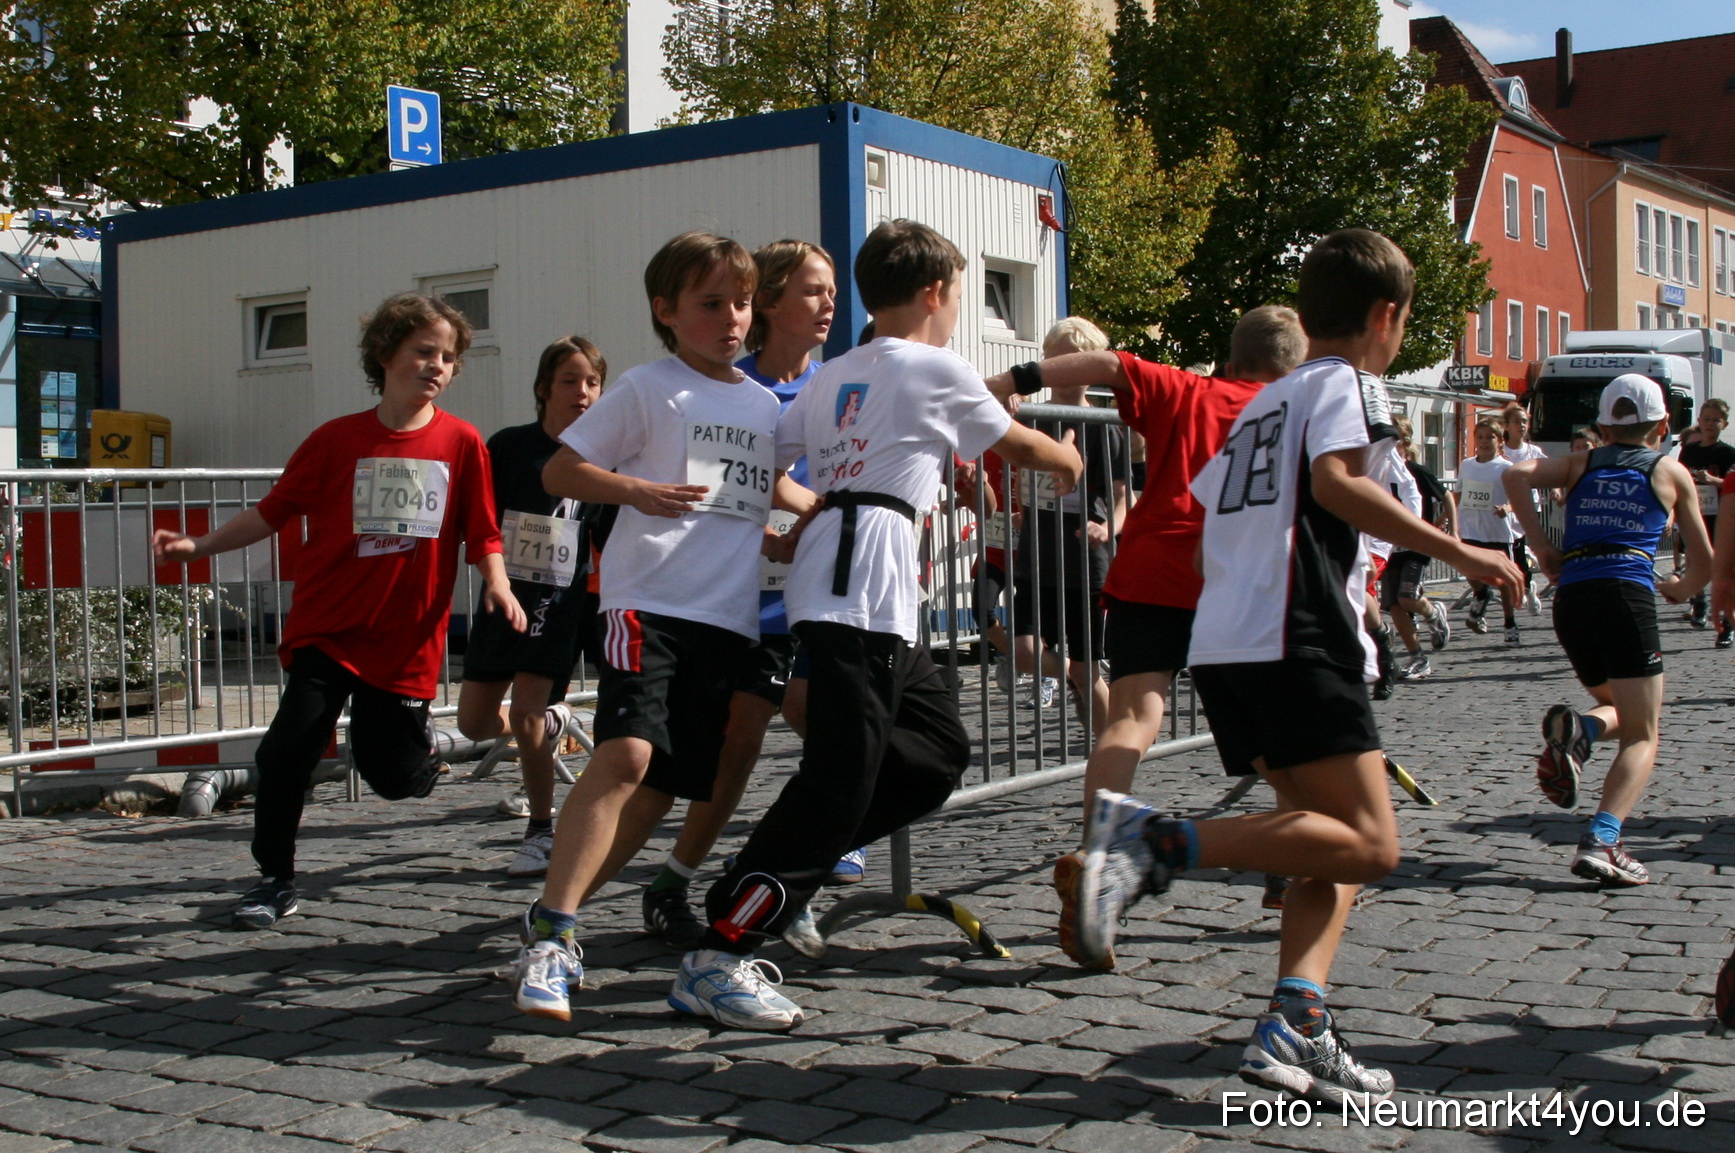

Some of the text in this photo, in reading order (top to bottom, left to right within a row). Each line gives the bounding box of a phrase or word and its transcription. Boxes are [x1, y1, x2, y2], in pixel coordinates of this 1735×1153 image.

[401, 98, 427, 152] P
[1570, 357, 1635, 369] BOCK
[1448, 367, 1484, 380] KBK
[693, 425, 756, 451] PATRICK
[1217, 401, 1288, 515] 13
[379, 463, 418, 479] Fabian
[720, 458, 769, 493] 7315
[1468, 491, 1490, 501] 7320
[1594, 480, 1640, 496] TSV
[380, 487, 438, 511] 7046
[1580, 498, 1647, 515] ZIRNDORF
[520, 518, 551, 535] Josua
[1575, 516, 1645, 532] TRIATHLON
[374, 536, 401, 549] DEHN
[520, 540, 570, 563] 7119
